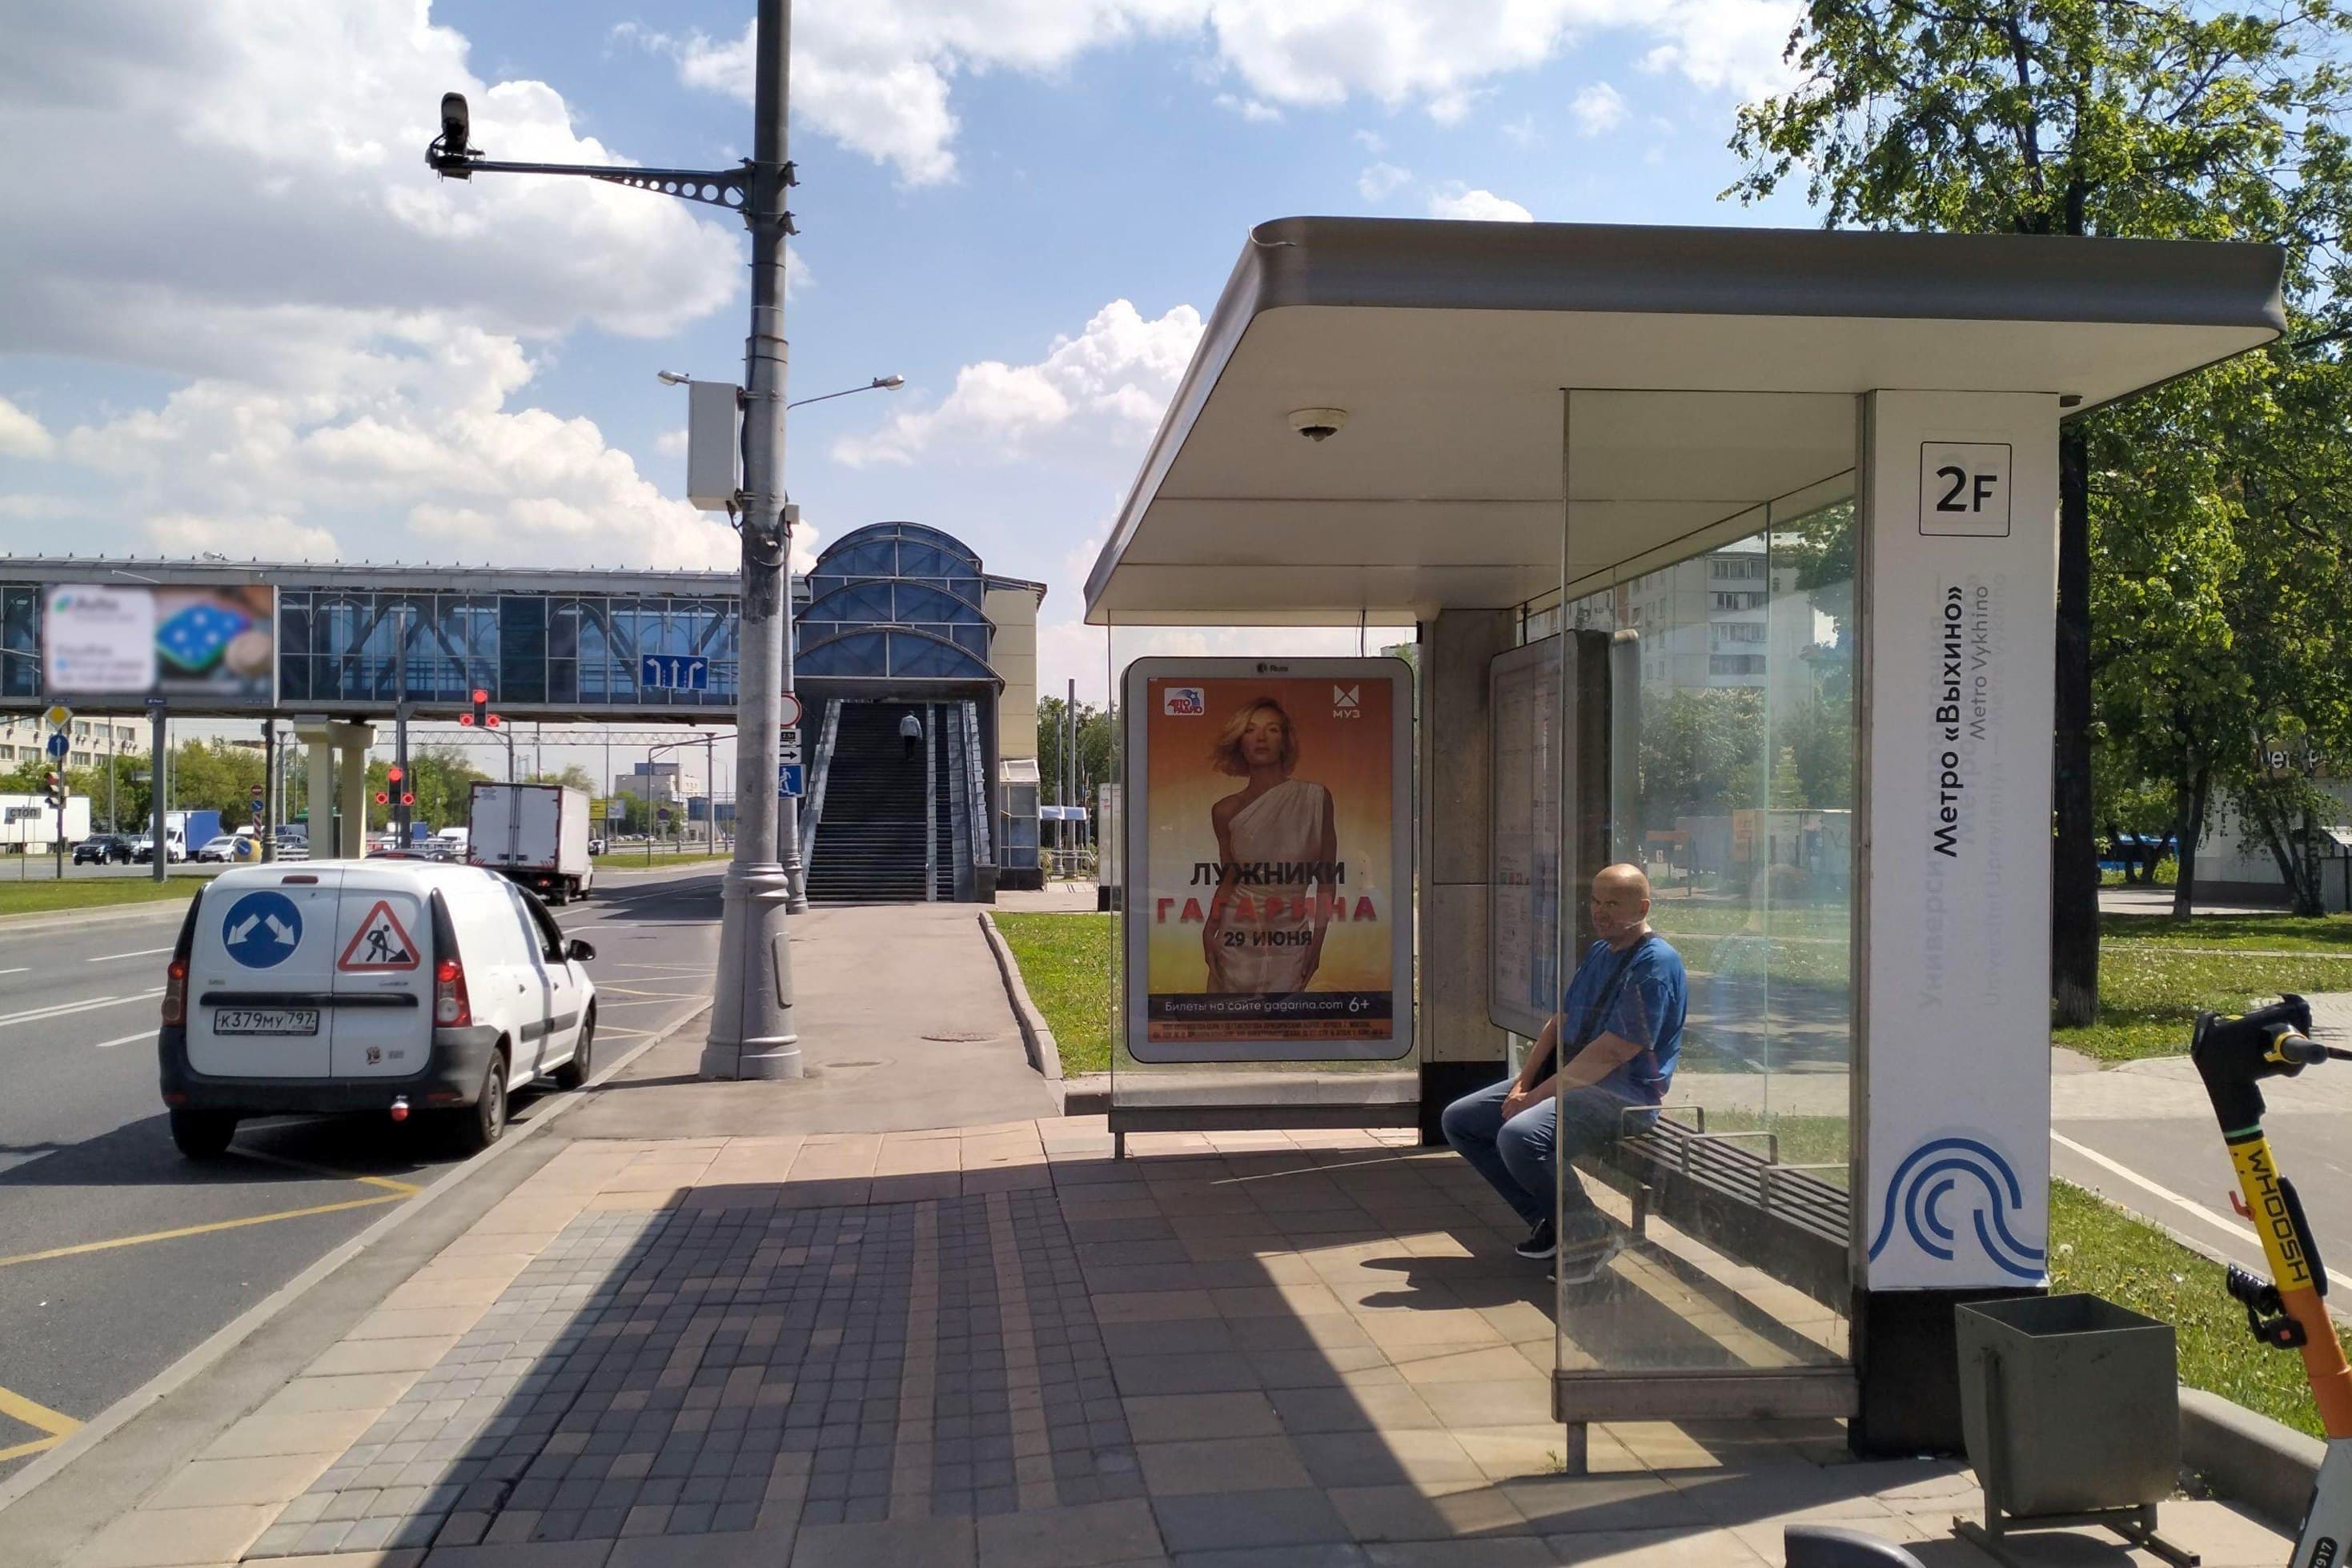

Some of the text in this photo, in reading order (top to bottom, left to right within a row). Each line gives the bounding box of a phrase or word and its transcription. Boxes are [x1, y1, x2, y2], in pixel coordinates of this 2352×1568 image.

[1936, 466, 1998, 513] 2F
[1971, 586, 1992, 671] Vykhino
[1333, 709, 1360, 718] МУЗ
[1969, 676, 1988, 741] Metro
[1933, 585, 1965, 858] Метро «Выхино»
[10, 808, 37, 817] СТОП
[1190, 861, 1345, 885] ЛУЖНИКИ
[1156, 896, 1378, 923] ГАГАРИНА
[1224, 930, 1313, 947] 29 ИЮНЯ
[1165, 997, 1371, 1013] Билеты на сайте gagarina.com 6+
[287, 1012, 313, 1025] 797
[2247, 1148, 2310, 1283] WHOOSH
